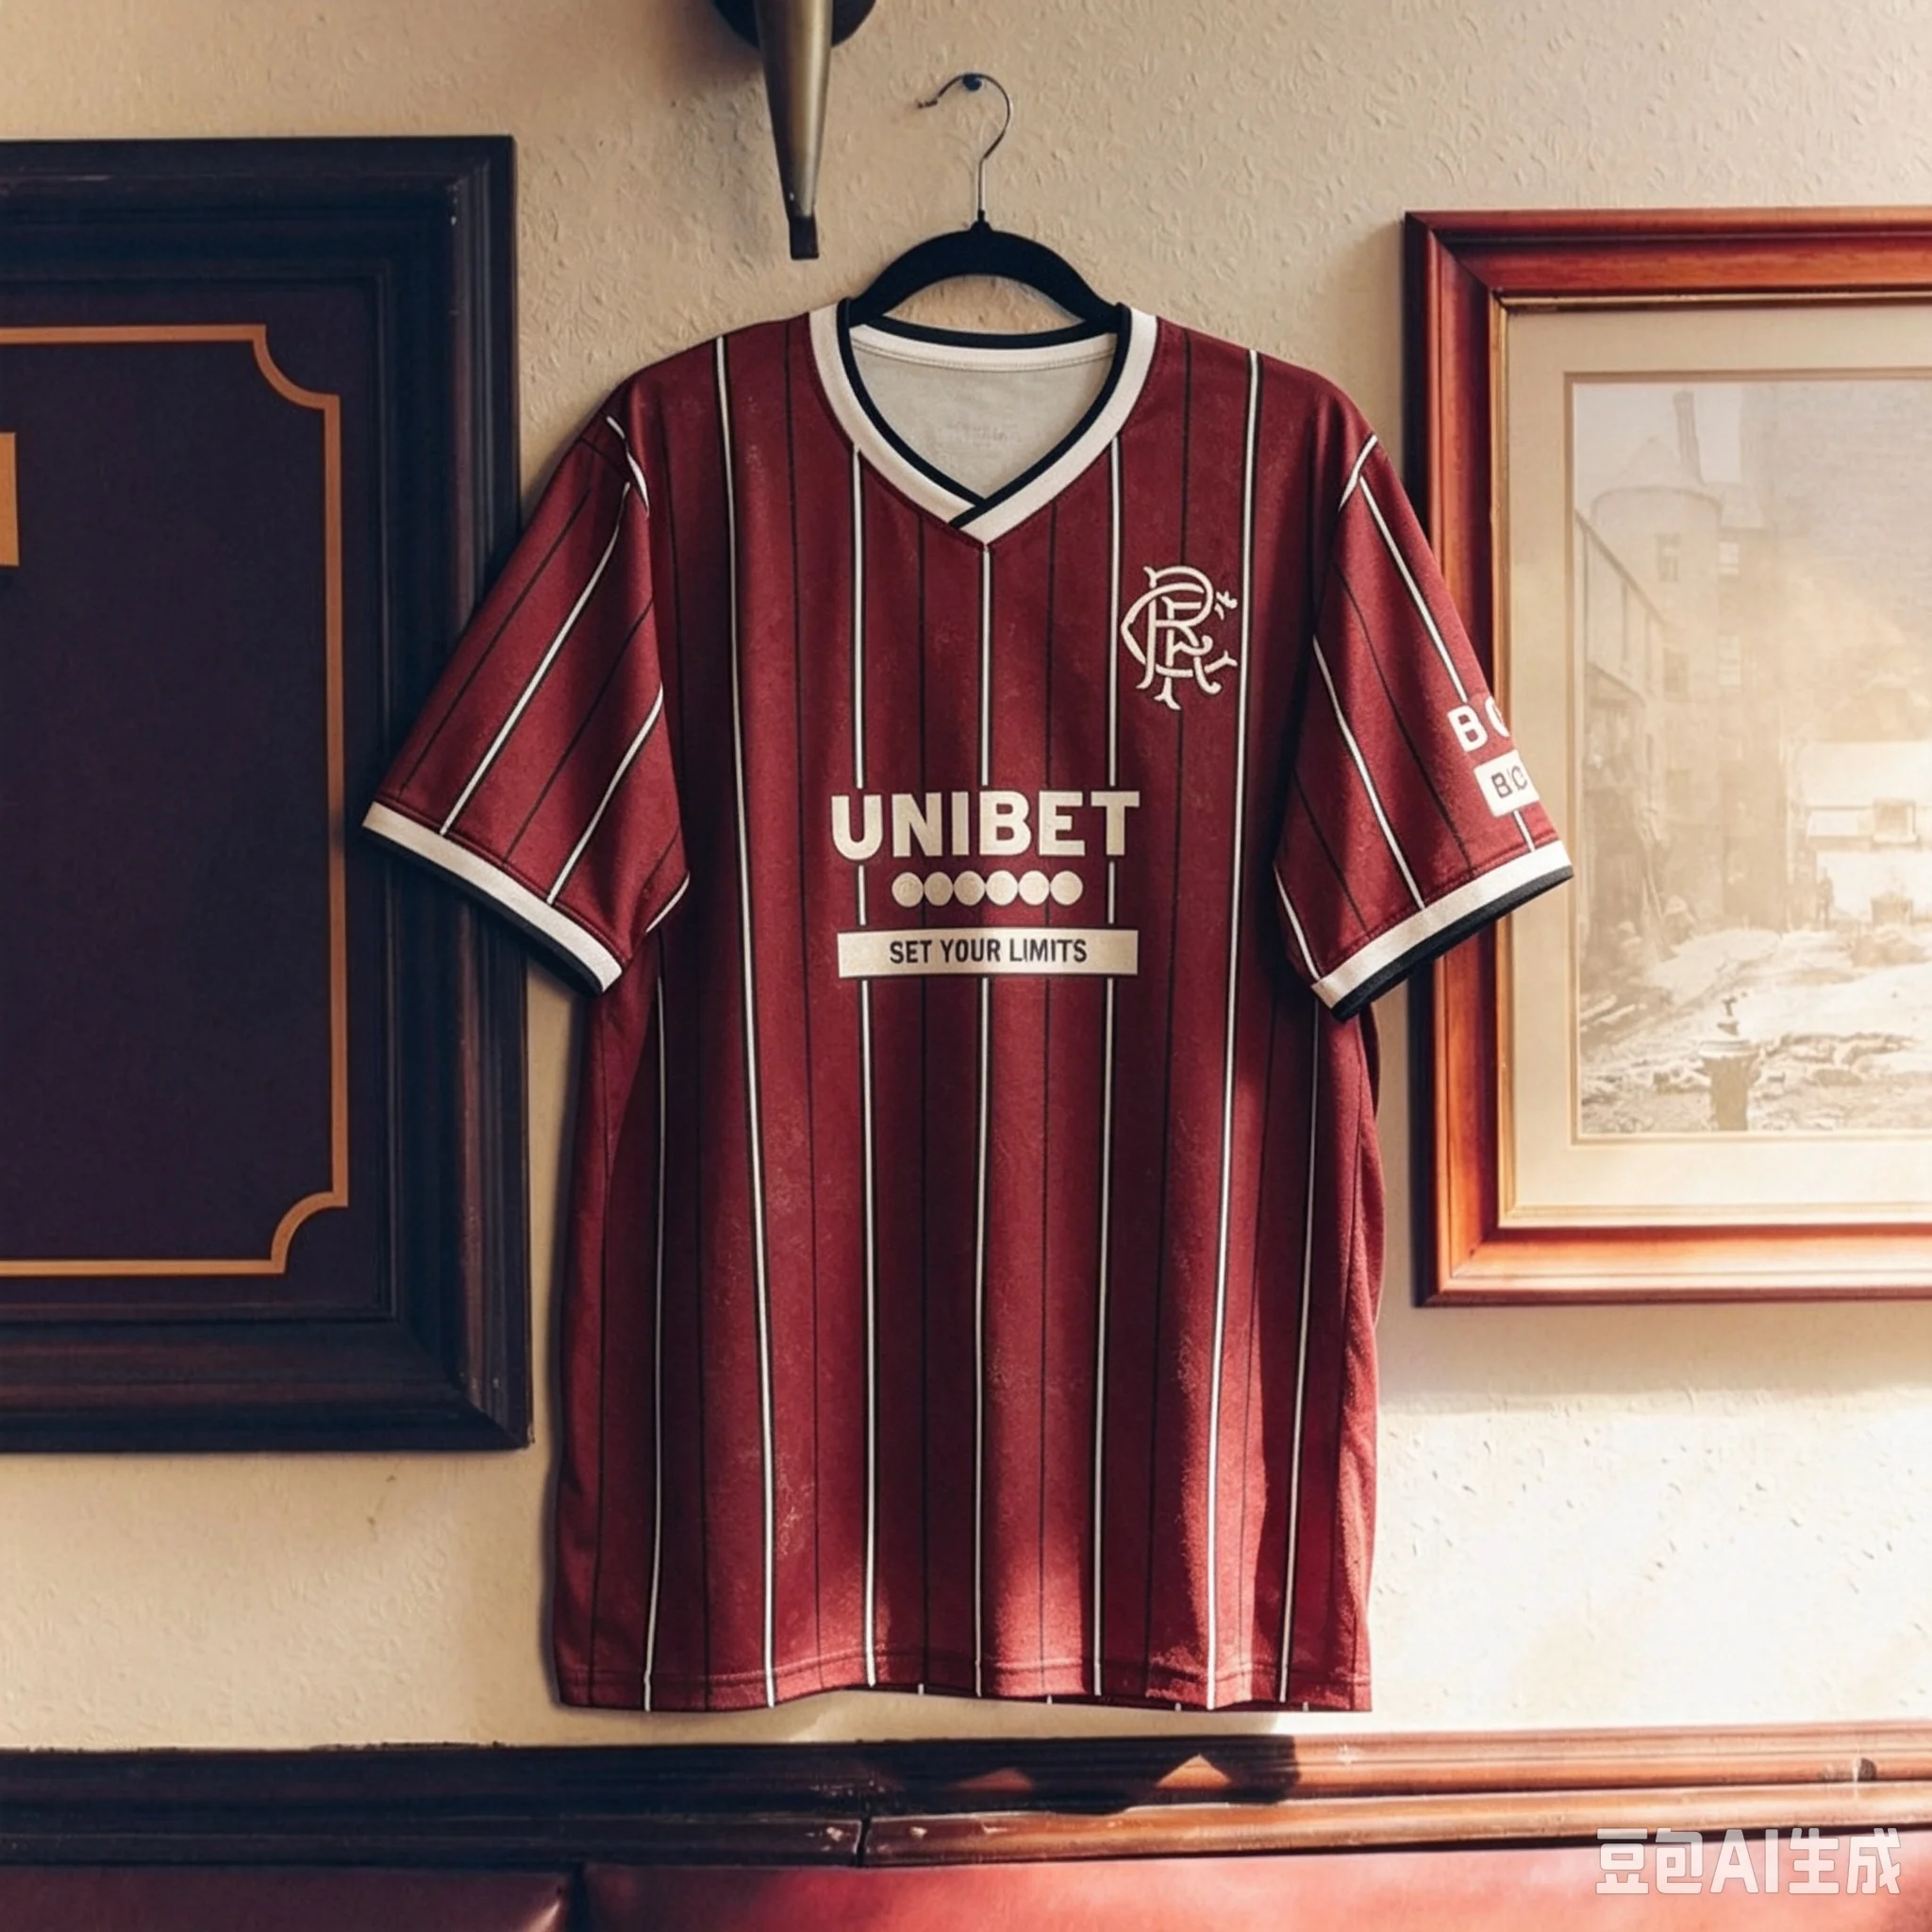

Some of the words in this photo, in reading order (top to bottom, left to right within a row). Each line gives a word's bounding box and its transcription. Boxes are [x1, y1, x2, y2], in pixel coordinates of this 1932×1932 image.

[831, 791, 1140, 860] UNIBET
[890, 941, 932, 964] SET
[941, 939, 1001, 963] YOUR
[1009, 939, 1088, 962] LIMITS
